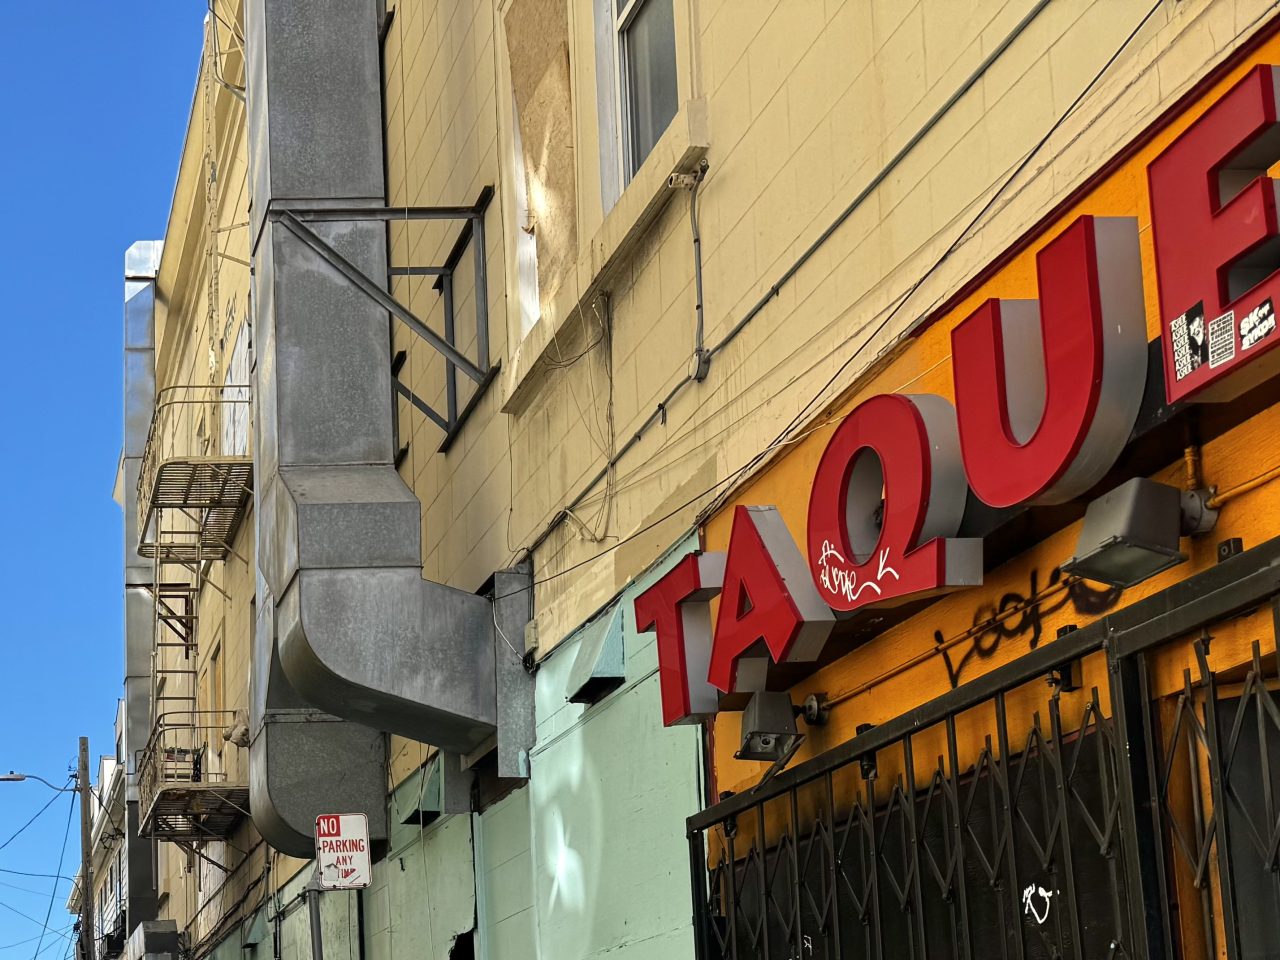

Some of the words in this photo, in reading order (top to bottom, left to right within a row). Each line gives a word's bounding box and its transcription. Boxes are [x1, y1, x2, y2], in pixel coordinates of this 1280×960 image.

[634, 64, 1280, 727] TAQUE
[320, 818, 337, 834] NO
[322, 839, 365, 853] PARKING
[336, 855, 353, 866] ANY
